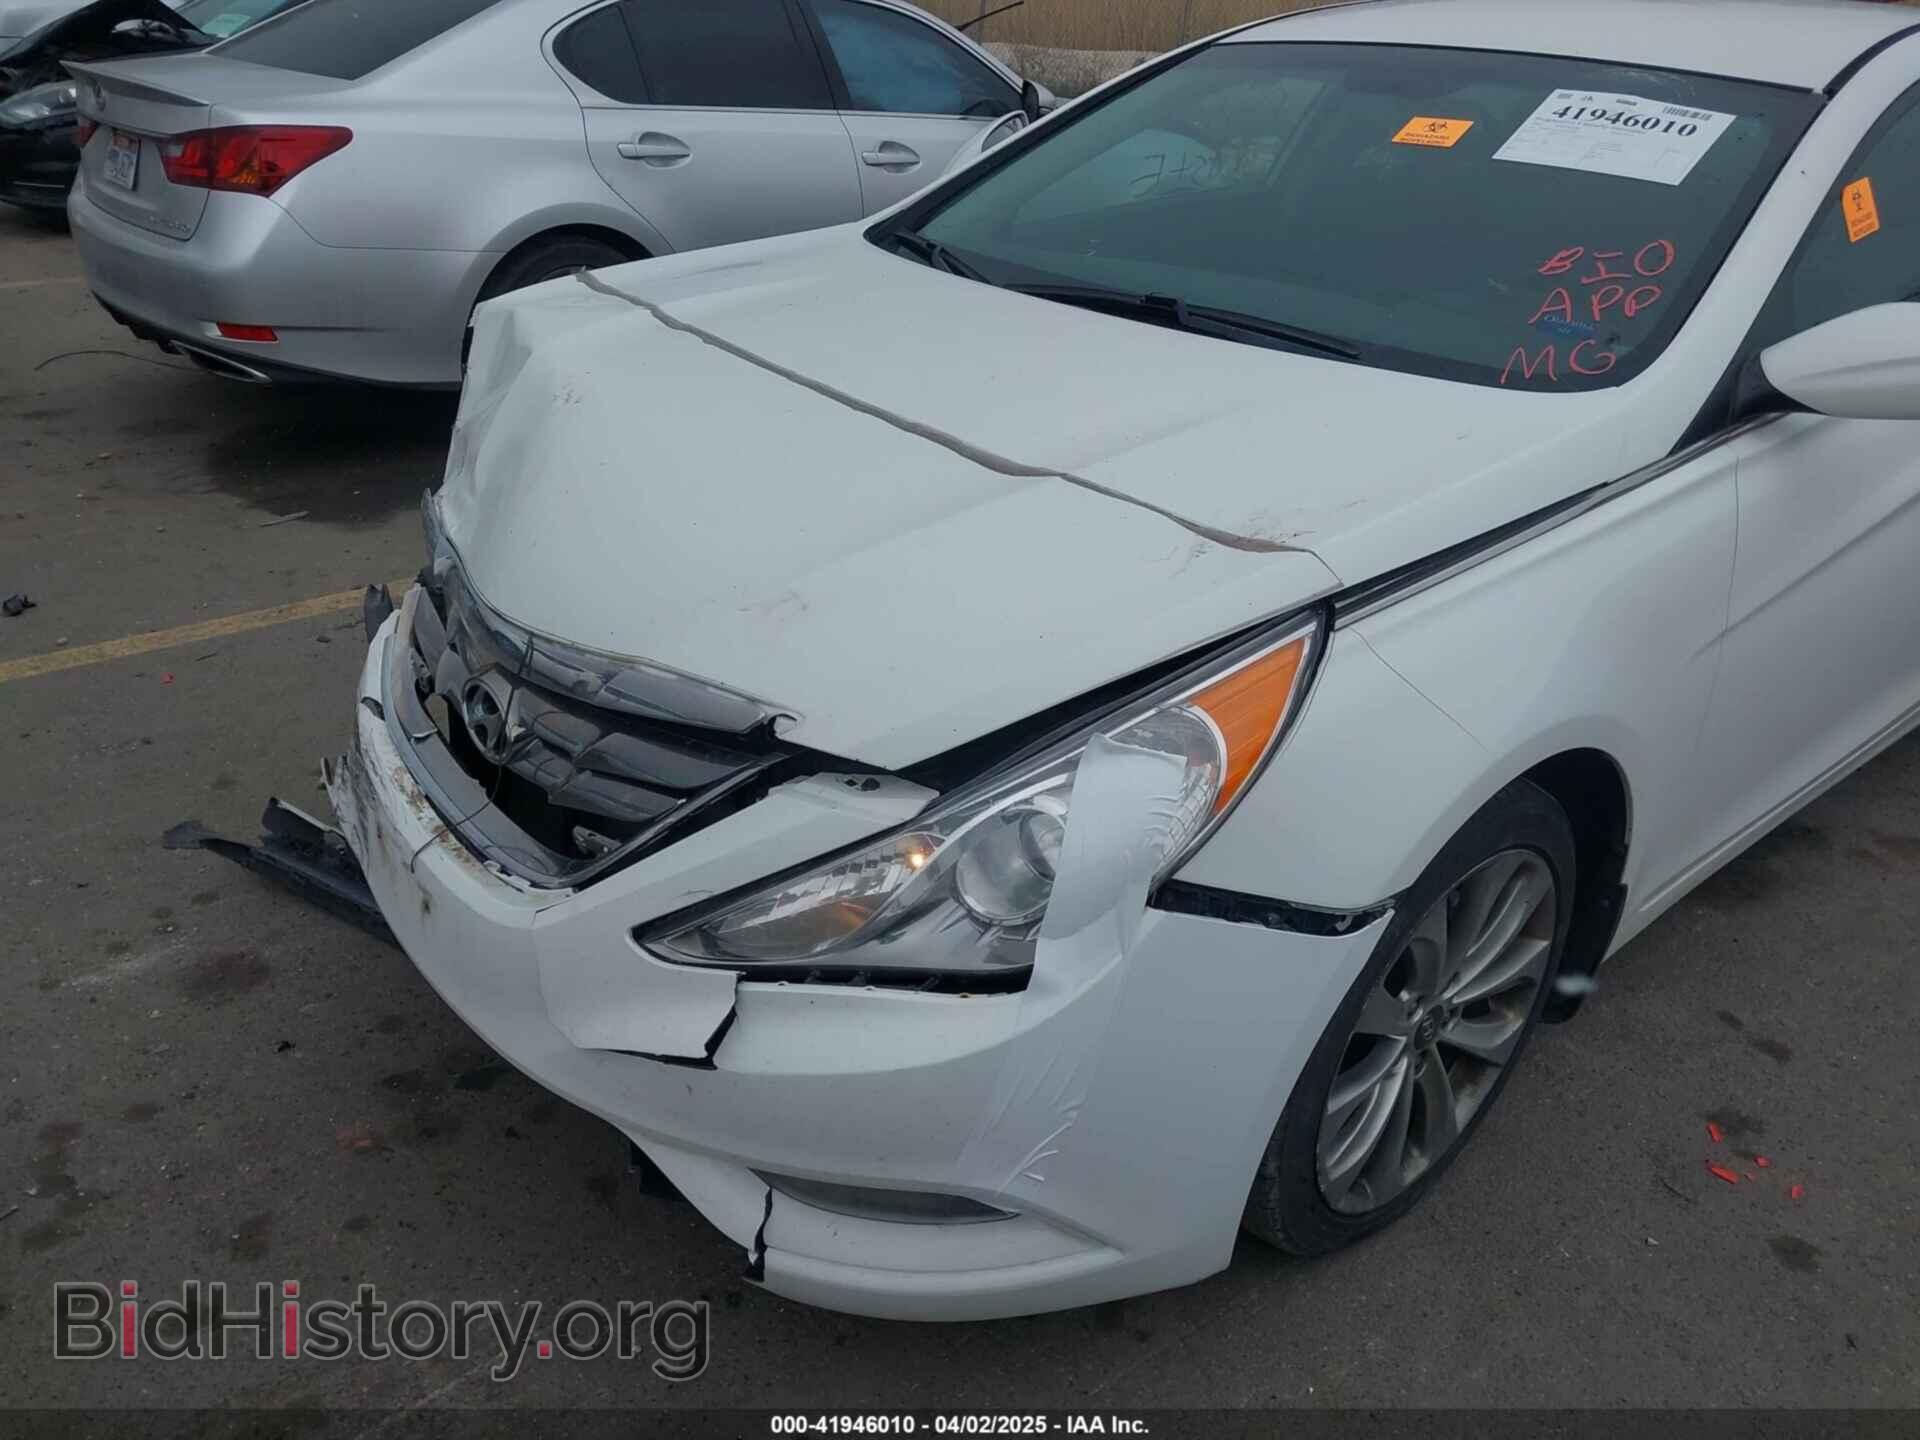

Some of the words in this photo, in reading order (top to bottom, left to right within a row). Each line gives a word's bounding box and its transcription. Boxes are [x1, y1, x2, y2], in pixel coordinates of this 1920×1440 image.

[1552, 105, 1698, 137] 41946010
[1537, 239, 1676, 285] BIO
[1527, 285, 1662, 324] APP
[1500, 339, 1617, 384] MG
